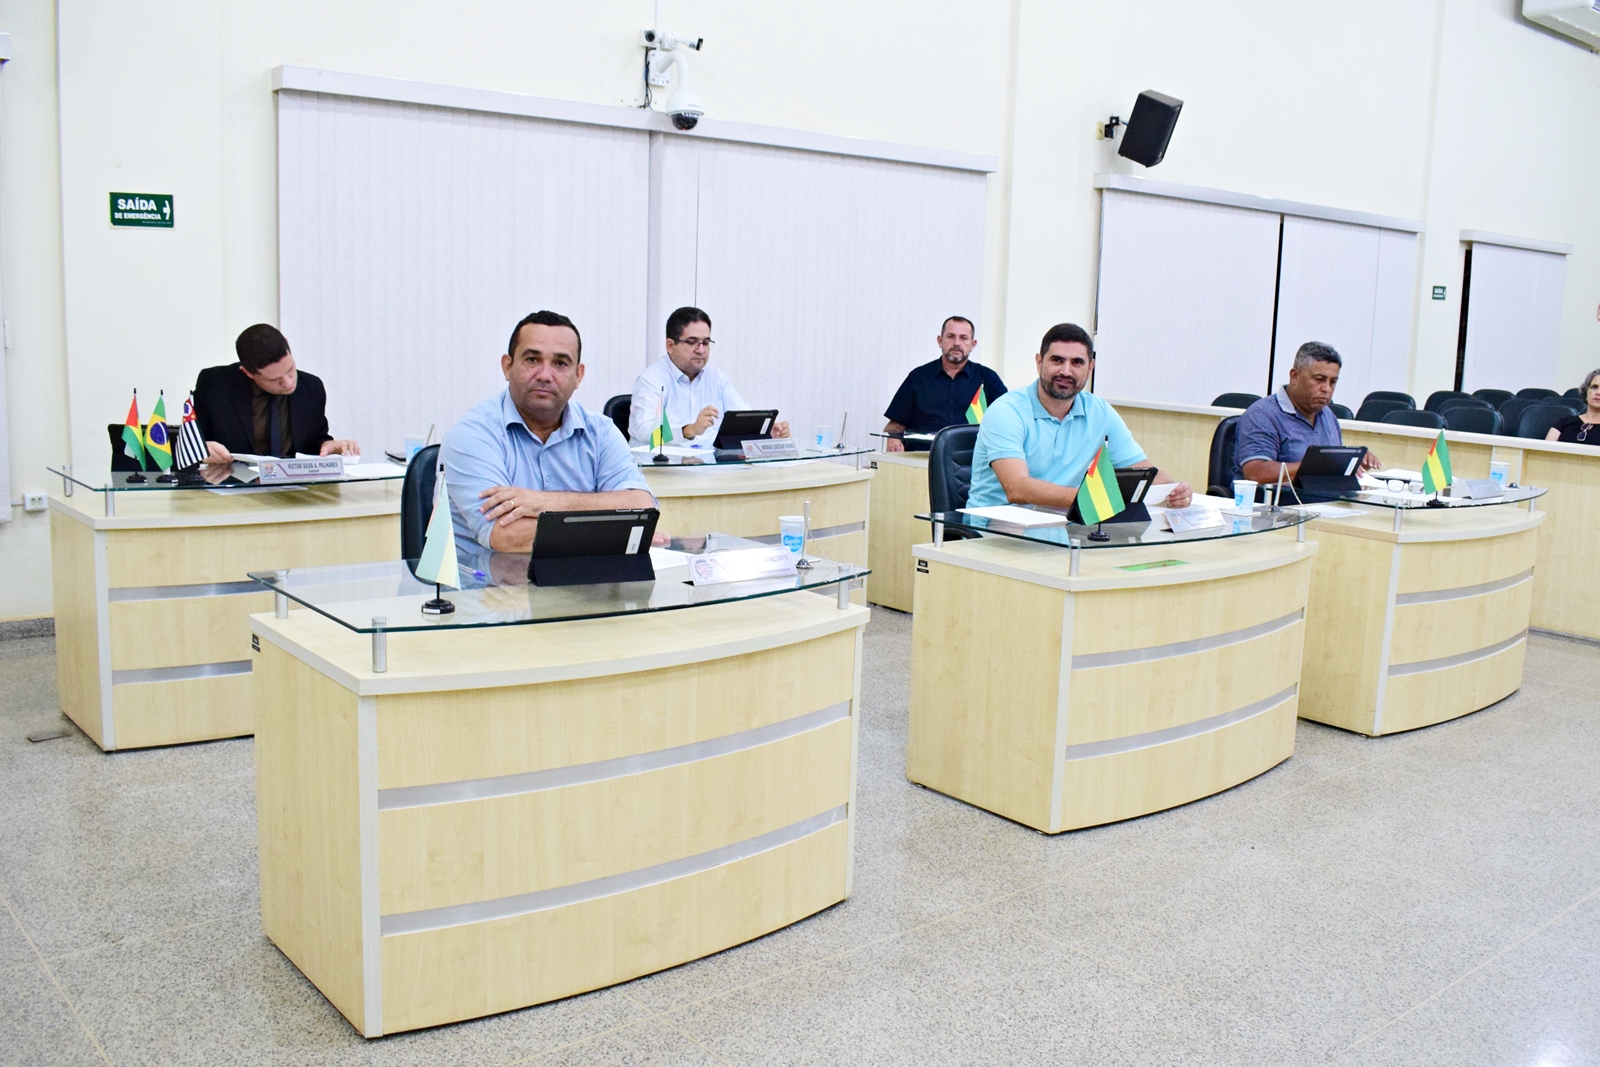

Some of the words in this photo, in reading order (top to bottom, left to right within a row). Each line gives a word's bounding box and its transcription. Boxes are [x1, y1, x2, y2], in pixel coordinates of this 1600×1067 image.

[117, 197, 157, 211] SAÍDA
[123, 212, 162, 220] EMERGÊNCIA
[287, 462, 302, 470] VICTOR
